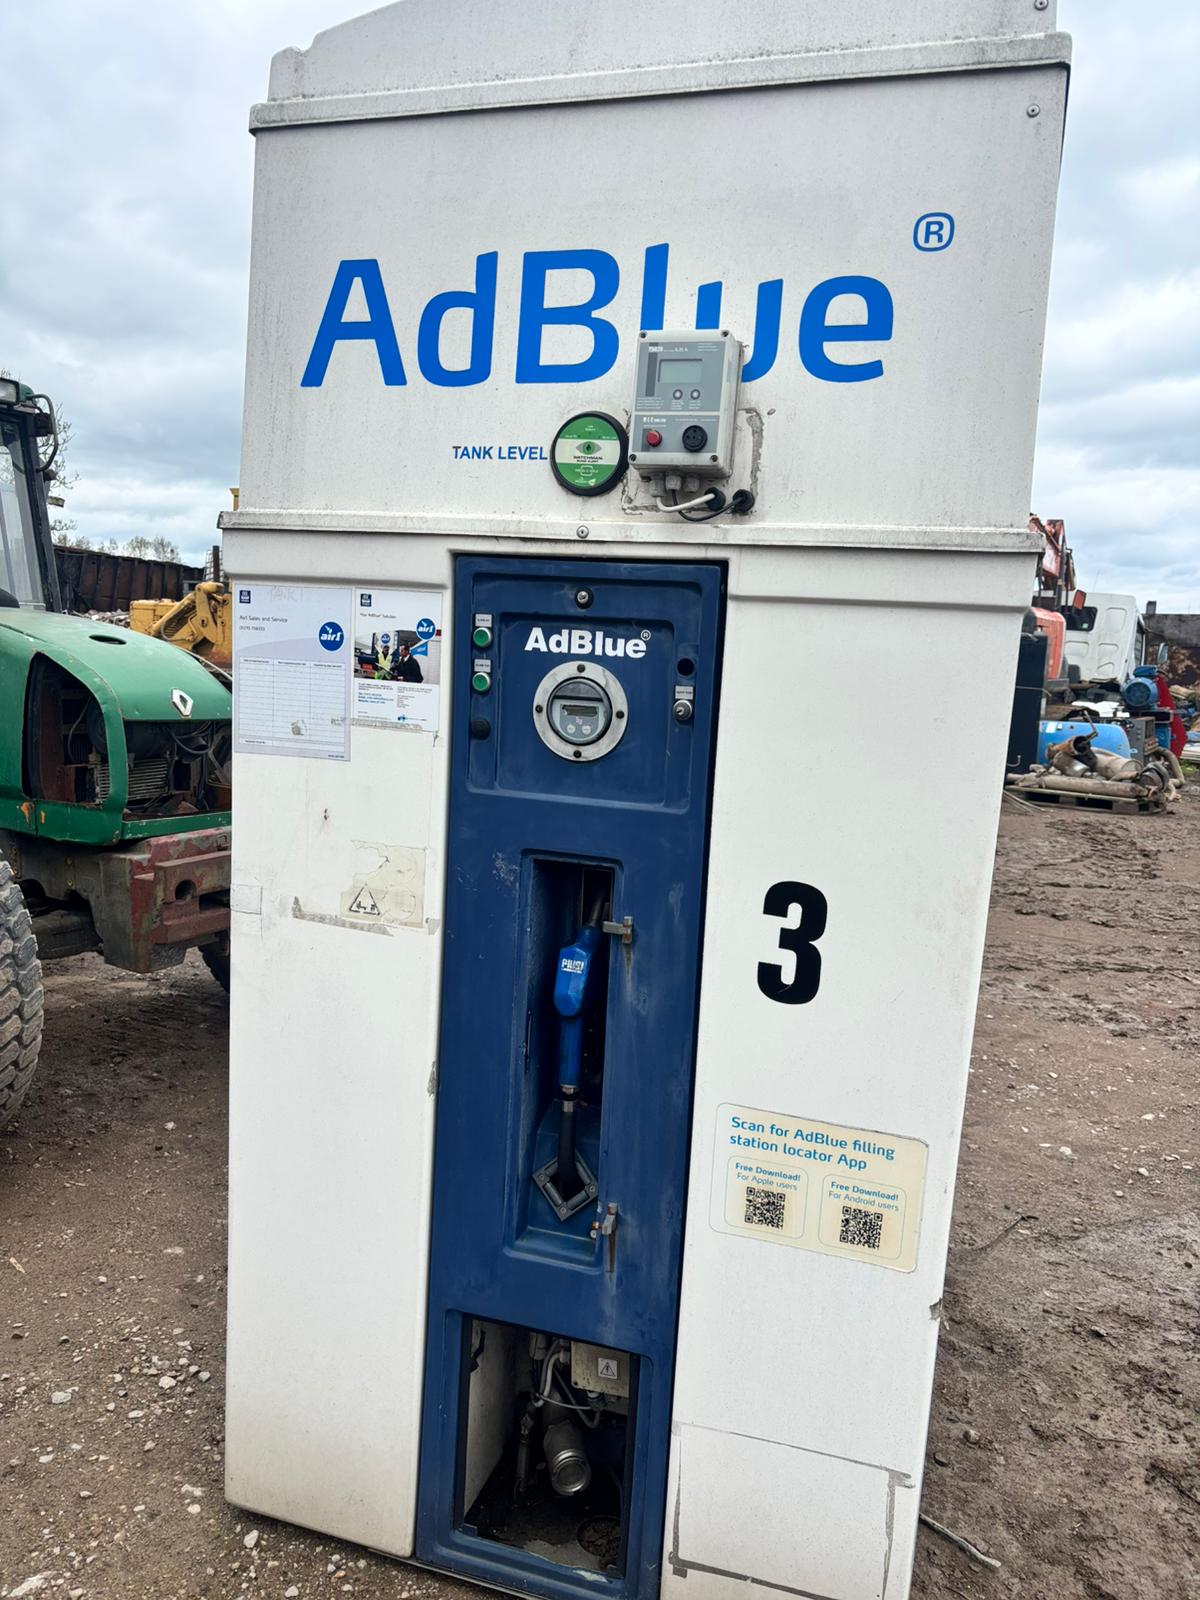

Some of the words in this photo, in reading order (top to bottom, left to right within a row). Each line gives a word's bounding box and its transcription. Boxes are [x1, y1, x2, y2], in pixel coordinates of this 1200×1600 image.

[301, 242, 894, 387] AdBlue
[452, 446, 493, 459] TANK
[498, 446, 548, 460] LEVEL
[320, 629, 343, 641] air1
[417, 622, 434, 633] air1
[757, 881, 828, 1005] 3
[731, 1116, 765, 1133] Scan
[769, 1123, 790, 1137] for
[793, 1129, 847, 1149] AdBlue
[852, 1139, 895, 1161] filling
[730, 1135, 778, 1153] station
[783, 1143, 833, 1162] locator
[837, 1153, 867, 1171] App
[735, 1162, 753, 1172] Free
[756, 1166, 801, 1181] Download!
[736, 1173, 749, 1181] For
[751, 1176, 774, 1186] Apple
[776, 1181, 798, 1191] users
[831, 1181, 850, 1191] Free
[852, 1185, 899, 1201] Download!
[828, 1190, 841, 1199] For
[843, 1193, 876, 1207] Android
[878, 1201, 900, 1211] users
